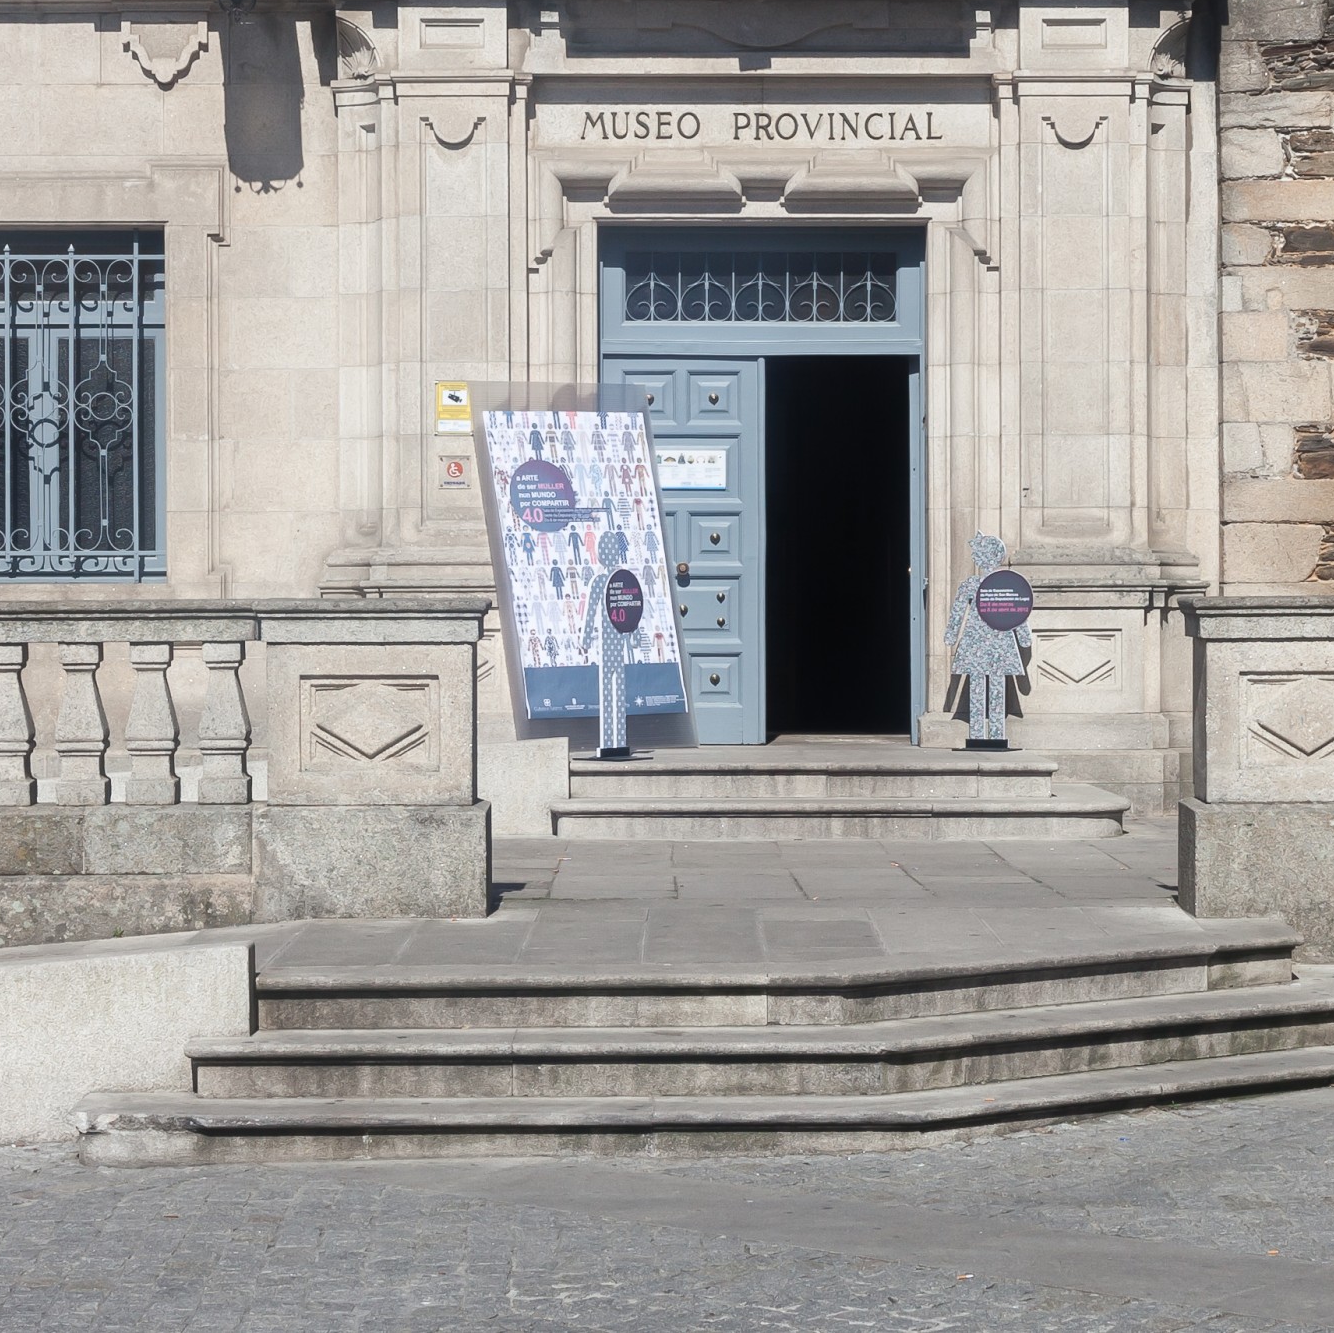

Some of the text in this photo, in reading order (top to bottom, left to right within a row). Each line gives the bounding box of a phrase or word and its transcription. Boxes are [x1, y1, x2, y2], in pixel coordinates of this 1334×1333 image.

[580, 111, 943, 141] MUSEO PROVINCIAL
[522, 508, 543, 523] 4.0
[611, 609, 625, 622] 4.0
